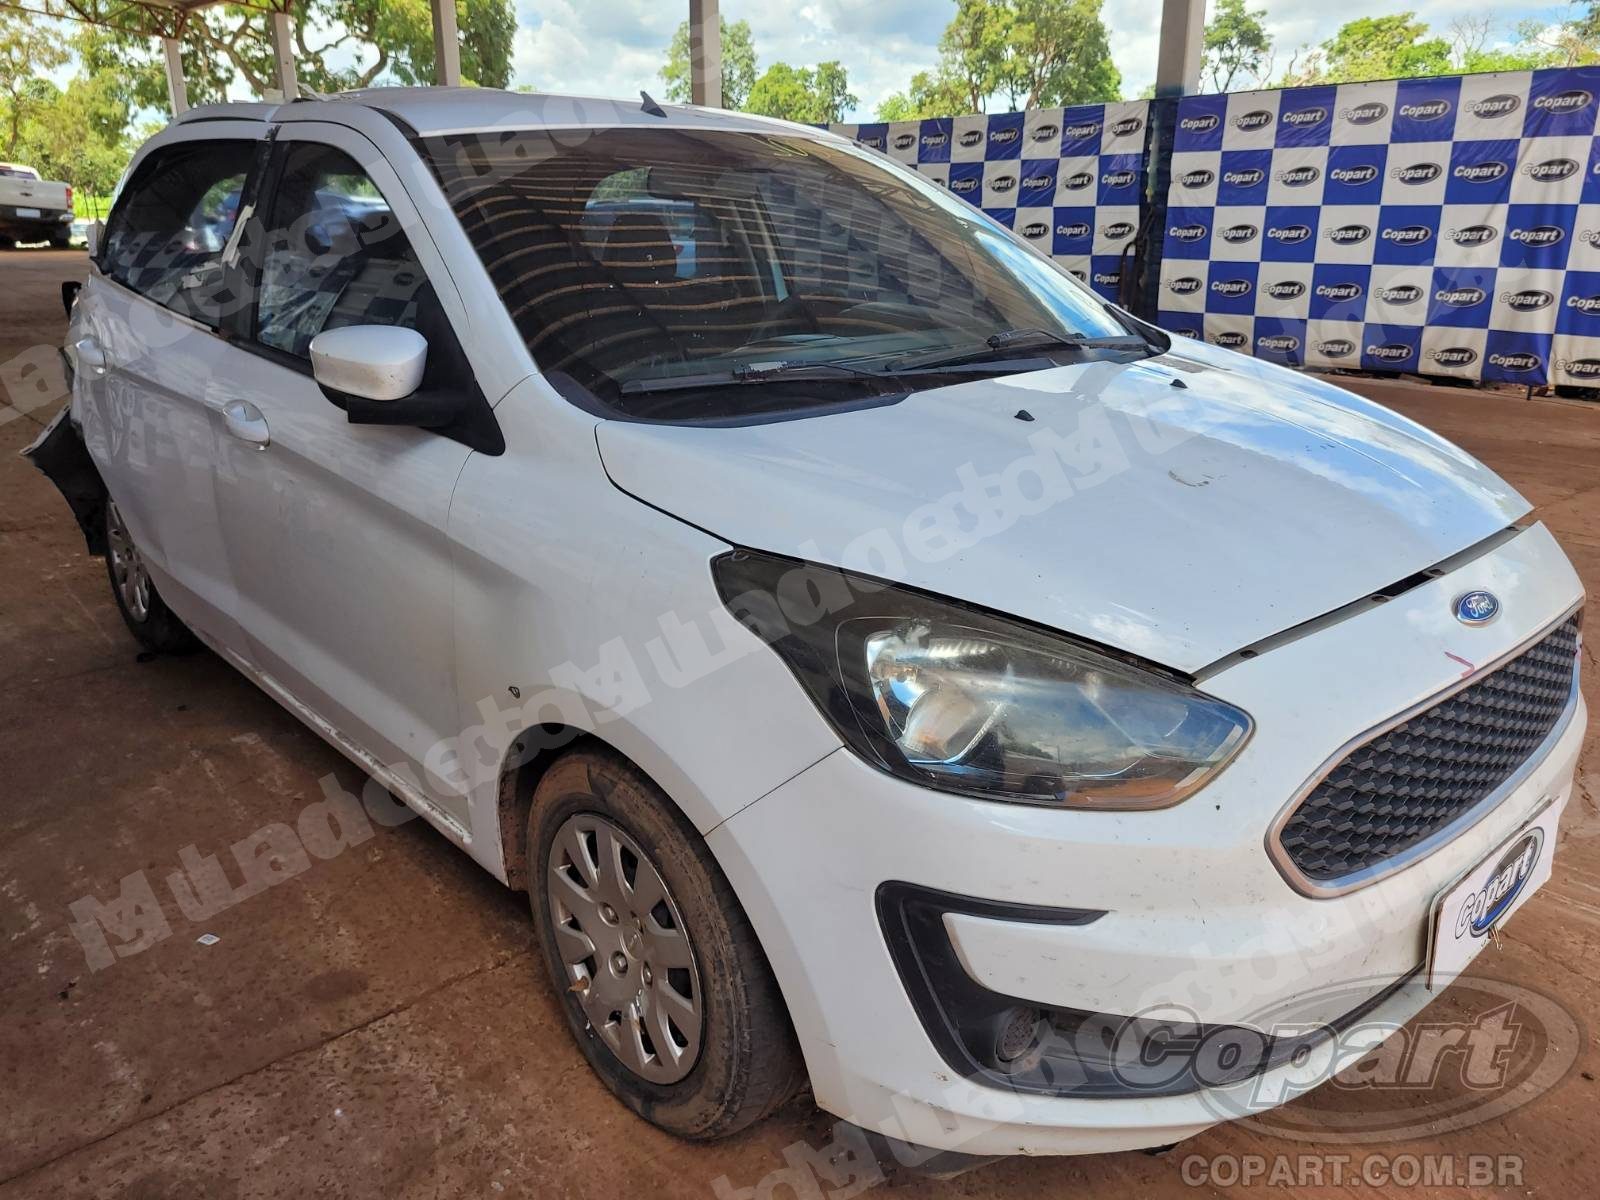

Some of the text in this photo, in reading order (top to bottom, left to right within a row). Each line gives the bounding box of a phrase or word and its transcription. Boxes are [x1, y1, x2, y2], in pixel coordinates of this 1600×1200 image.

[1464, 97, 1512, 118] Copart
[1533, 91, 1585, 112] Copart
[1282, 109, 1324, 126] Copart
[1339, 105, 1381, 124] Copart
[1400, 103, 1446, 120] Copart
[1180, 115, 1216, 130] Copart
[1231, 112, 1267, 130] Copart
[990, 131, 1016, 143] Copart
[1066, 124, 1096, 137] Copart
[1102, 172, 1133, 186] Copart
[1223, 170, 1260, 186] Copart
[1274, 168, 1315, 186] Copart
[1331, 166, 1376, 183] Copart
[1391, 165, 1436, 183] Copart
[1454, 162, 1502, 181] Copart
[1521, 161, 1570, 181] Copart
[952, 178, 976, 190] Copart
[1022, 176, 1049, 189] Copart
[1057, 224, 1086, 237] Copart
[1169, 226, 1204, 240] Copart
[1217, 226, 1253, 242] Copart
[1267, 227, 1307, 243] Copart
[1323, 226, 1366, 243] Copart
[1381, 228, 1427, 244] Copart
[1445, 228, 1490, 245] Copart
[1510, 228, 1559, 245] Copart
[1094, 273, 1120, 286] Copar
[1165, 278, 1199, 293] Copart
[1211, 281, 1249, 297] Copart
[1263, 283, 1300, 299] Copart
[1316, 284, 1359, 302] Copart
[1374, 287, 1418, 304] Copart
[1435, 290, 1481, 307] Copart
[1499, 291, 1548, 310] Copart
[1257, 336, 1295, 353] Copart
[1312, 340, 1351, 356] Copart
[1366, 345, 1409, 362] Copart
[1426, 347, 1471, 365] Copart
[1489, 353, 1536, 371] Copart
[1465, 594, 1494, 617] Ford
[1455, 836, 1537, 939] Copart
